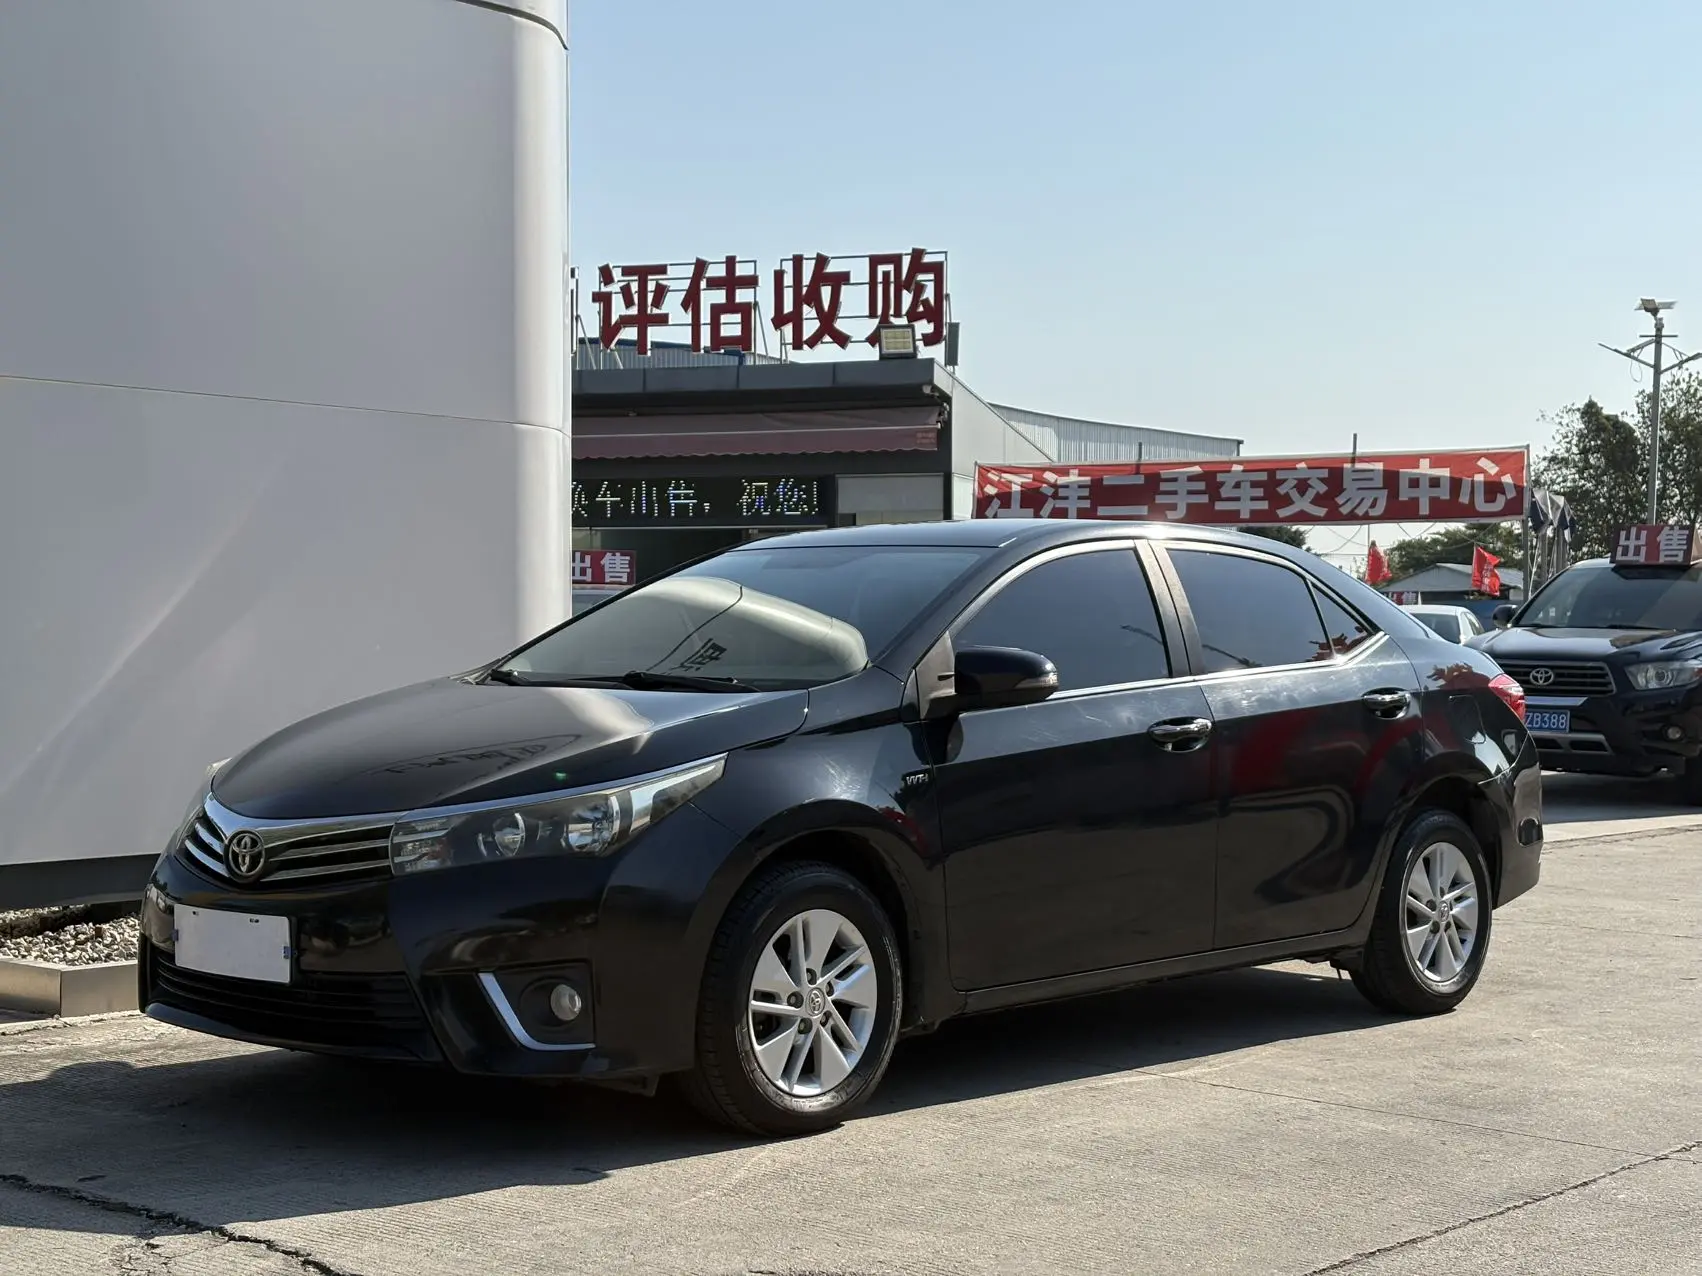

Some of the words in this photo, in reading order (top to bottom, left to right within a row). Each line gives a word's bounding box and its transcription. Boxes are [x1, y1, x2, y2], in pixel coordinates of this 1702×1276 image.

[591, 247, 945, 355] 评估收购
[983, 456, 1516, 519] 江沣二手车交易中心
[1616, 526, 1689, 563] 出售
[1525, 712, 1567, 729] ZB388
